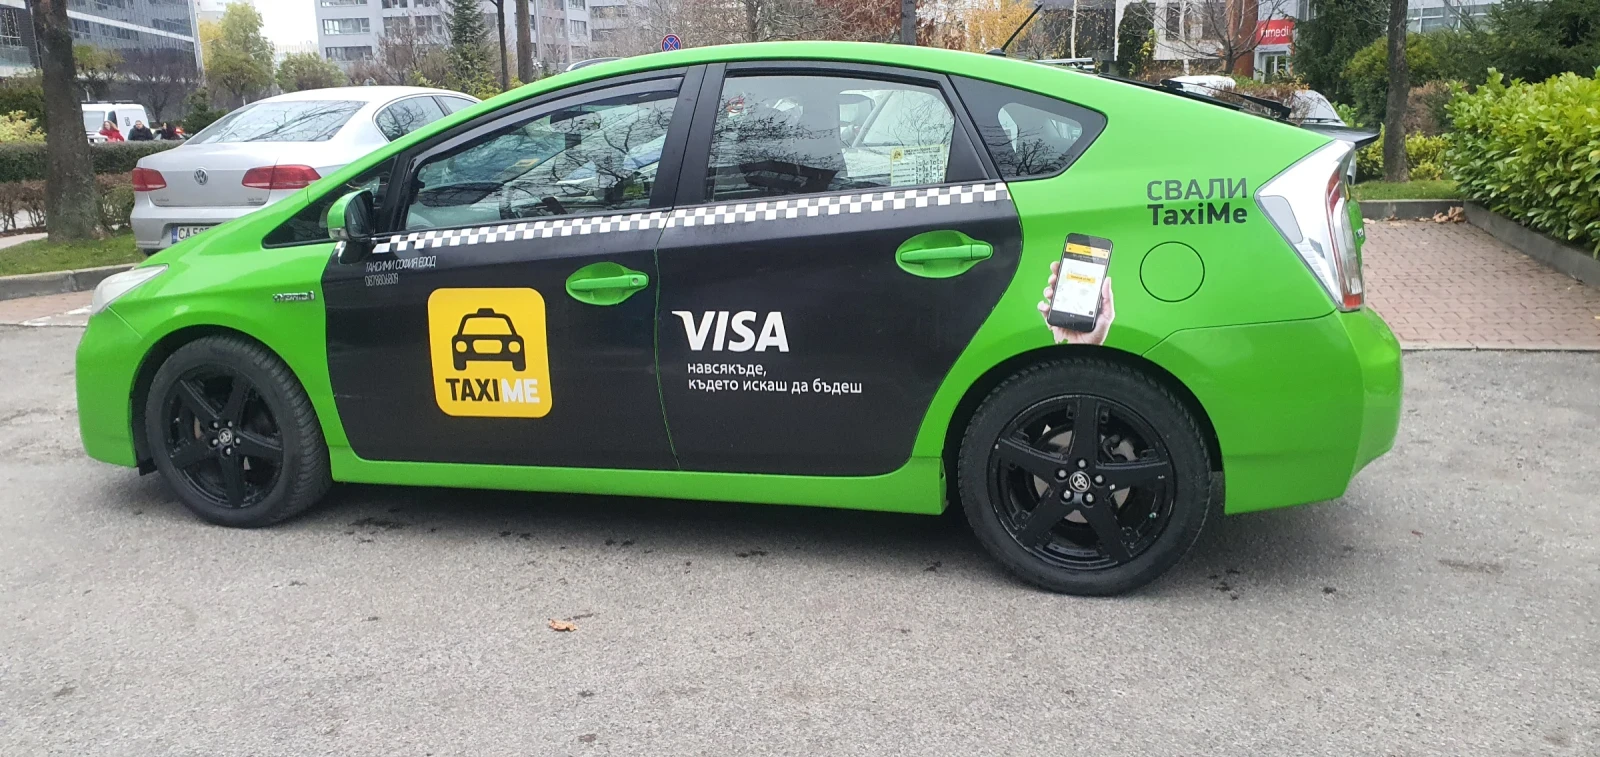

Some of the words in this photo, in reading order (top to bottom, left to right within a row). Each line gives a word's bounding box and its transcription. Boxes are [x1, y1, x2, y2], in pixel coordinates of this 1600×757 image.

[1147, 178, 1248, 201] СВАЛИ
[1147, 202, 1248, 225] TaxiMe
[672, 310, 790, 352] VISA
[687, 362, 767, 377] навсякъде,
[688, 378, 739, 392] където
[743, 381, 788, 392] искаш
[791, 382, 809, 395] да
[812, 378, 862, 395] бъдеш
